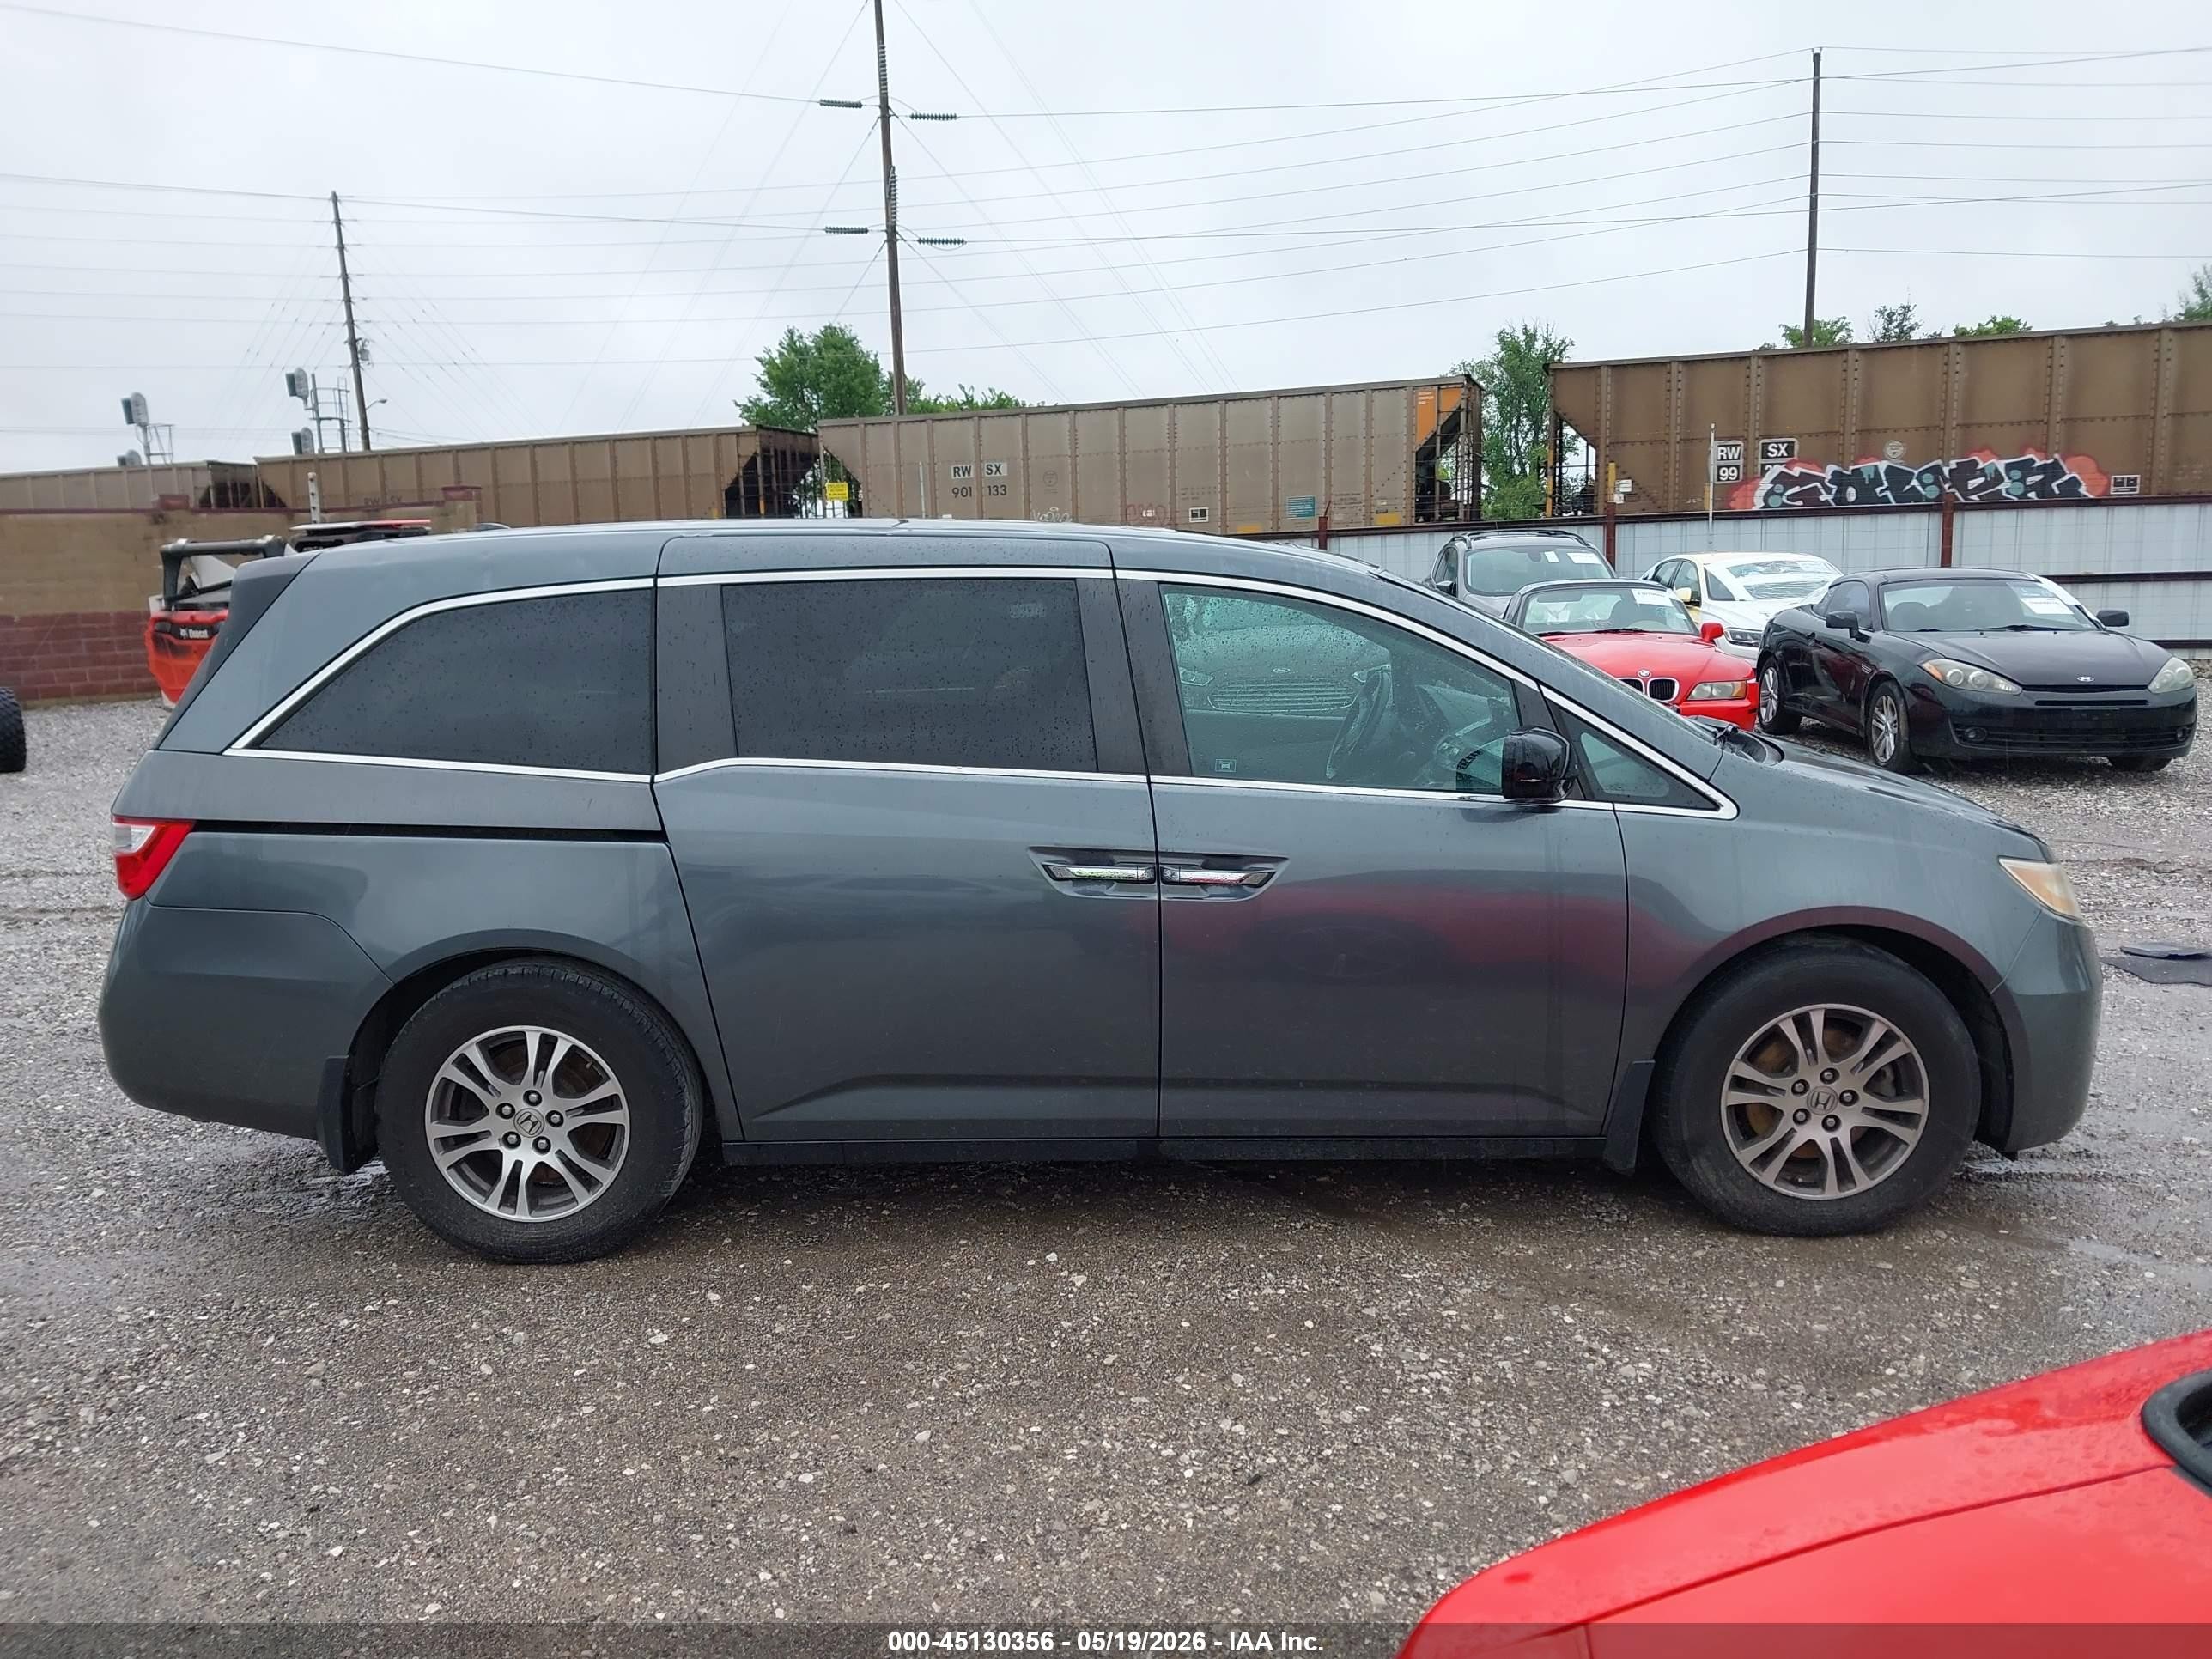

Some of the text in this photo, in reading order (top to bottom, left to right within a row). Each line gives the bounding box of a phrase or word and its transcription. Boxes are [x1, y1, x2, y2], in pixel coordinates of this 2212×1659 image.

[1717, 443, 1789, 460] RW SX
[953, 463, 1003, 477] RW SX
[1718, 466, 1739, 481] 99
[951, 484, 1008, 498] 901 133
